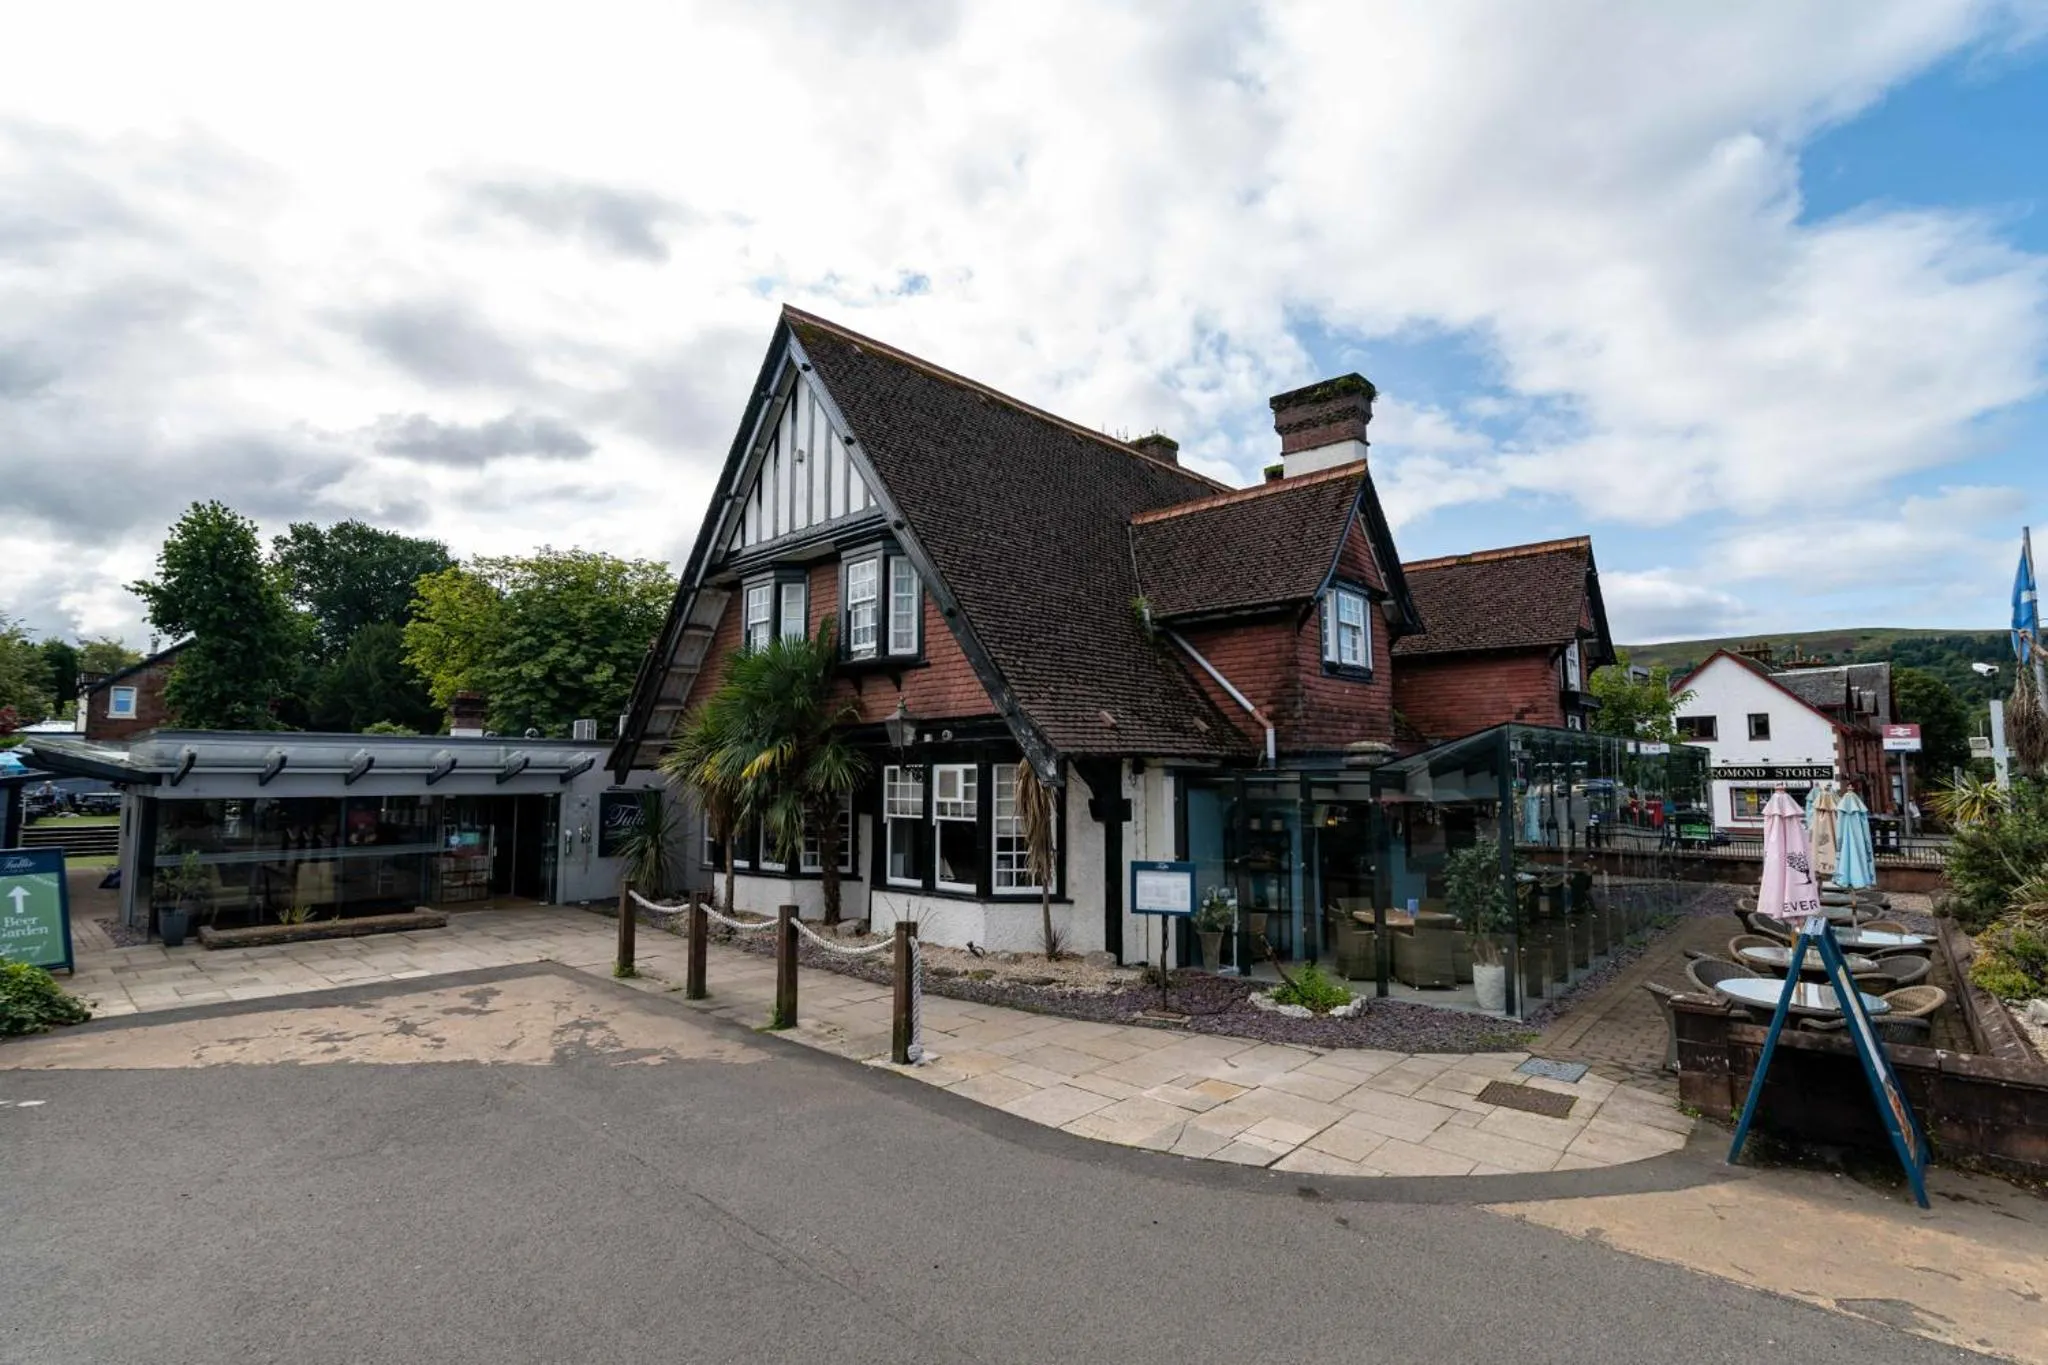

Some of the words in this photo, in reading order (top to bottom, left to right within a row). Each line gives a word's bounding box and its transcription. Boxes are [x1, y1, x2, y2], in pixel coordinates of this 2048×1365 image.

[1775, 767, 1831, 778] STORES
[1783, 899, 1818, 913] EVER
[4, 916, 39, 927] Beer
